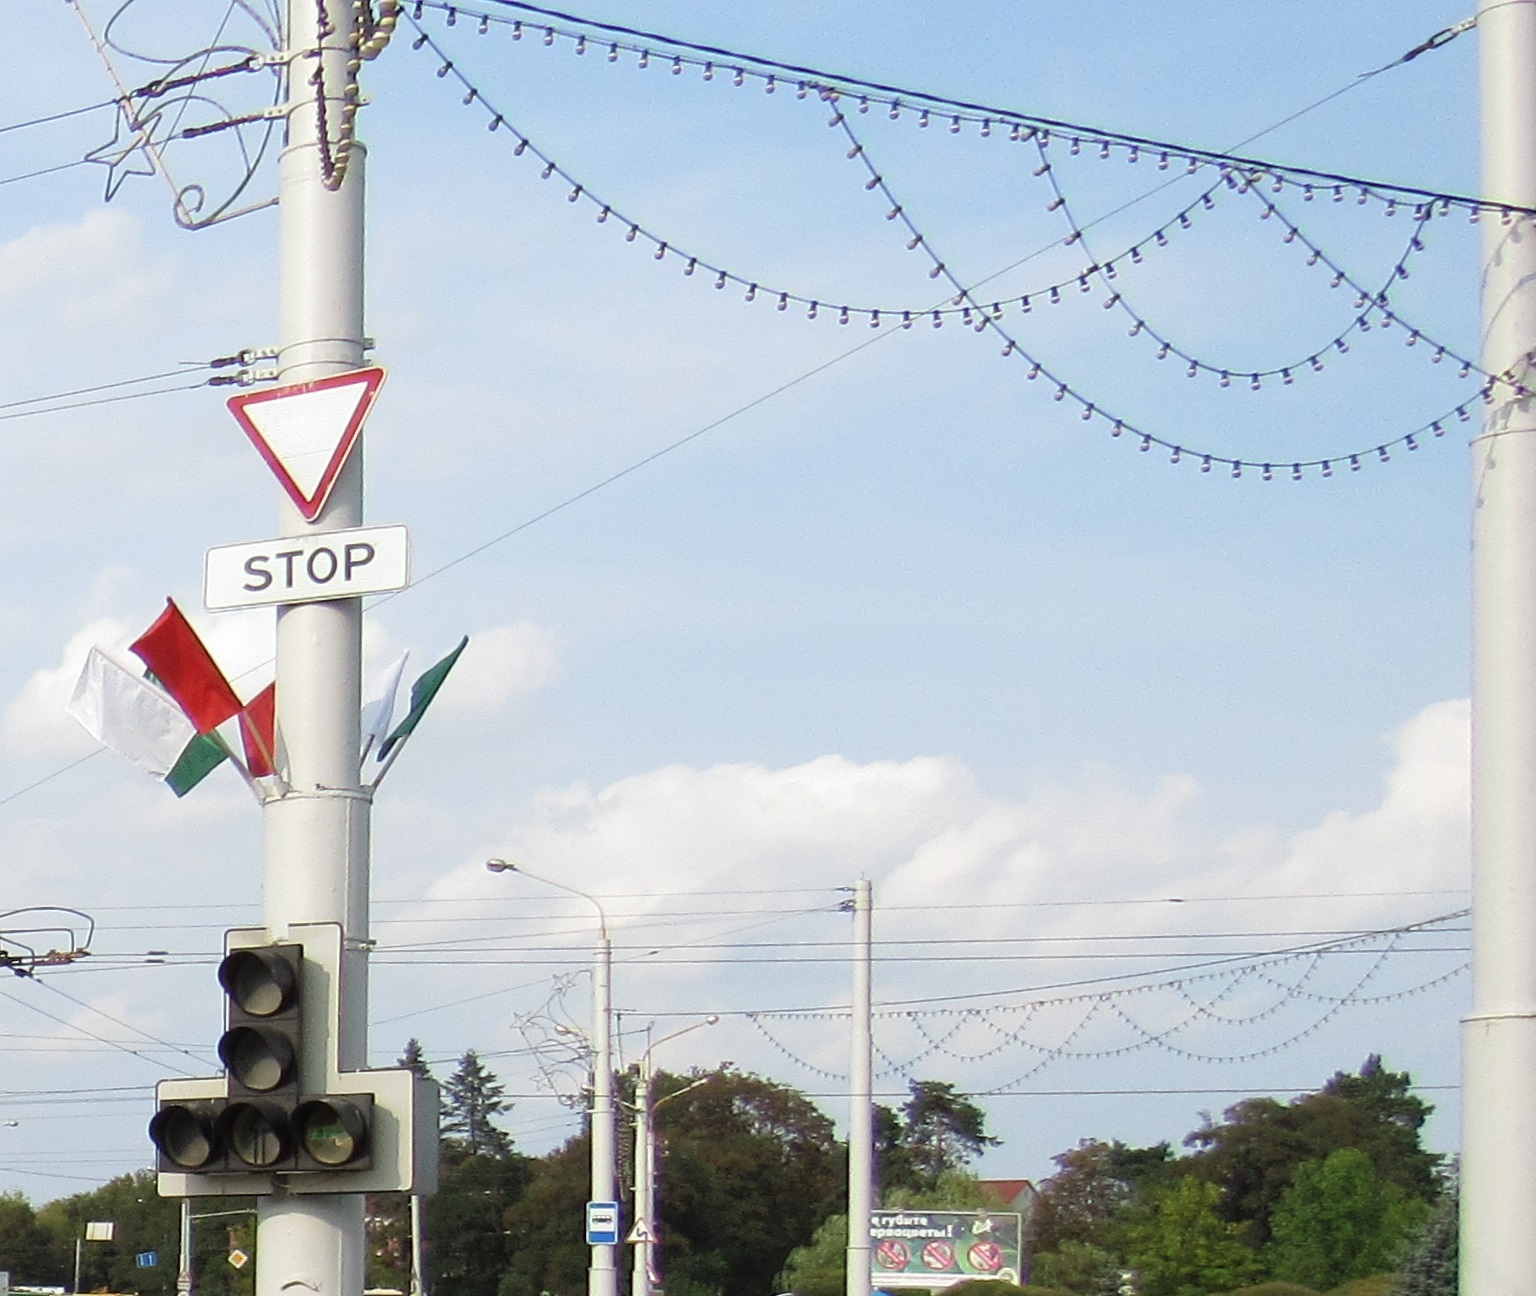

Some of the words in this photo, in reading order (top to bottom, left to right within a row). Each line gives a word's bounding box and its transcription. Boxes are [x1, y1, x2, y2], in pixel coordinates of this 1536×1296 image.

[242, 542, 376, 592] STOP
[881, 1214, 928, 1228] губите
[870, 1224, 953, 1239] ервоцветы!
